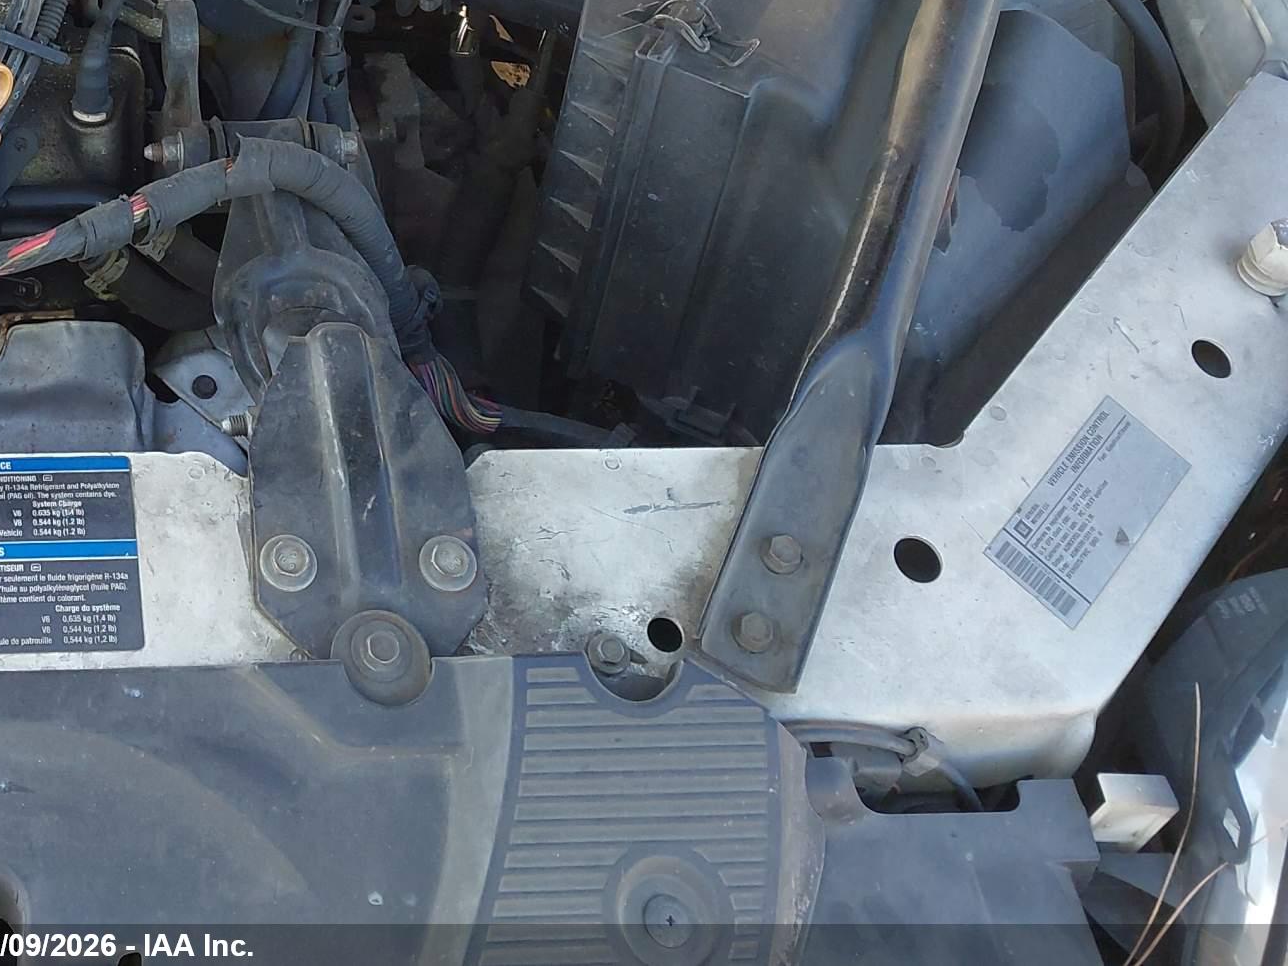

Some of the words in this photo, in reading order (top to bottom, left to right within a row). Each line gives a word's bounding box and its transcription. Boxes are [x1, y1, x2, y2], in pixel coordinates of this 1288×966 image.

[1047, 461, 1069, 487] VEHICLE
[1065, 433, 1090, 464] EMISSION
[1086, 409, 1109, 437] CONTROL
[1070, 432, 1104, 474] INFORMATION
[32, 500, 57, 508] System
[58, 500, 82, 508] Charge
